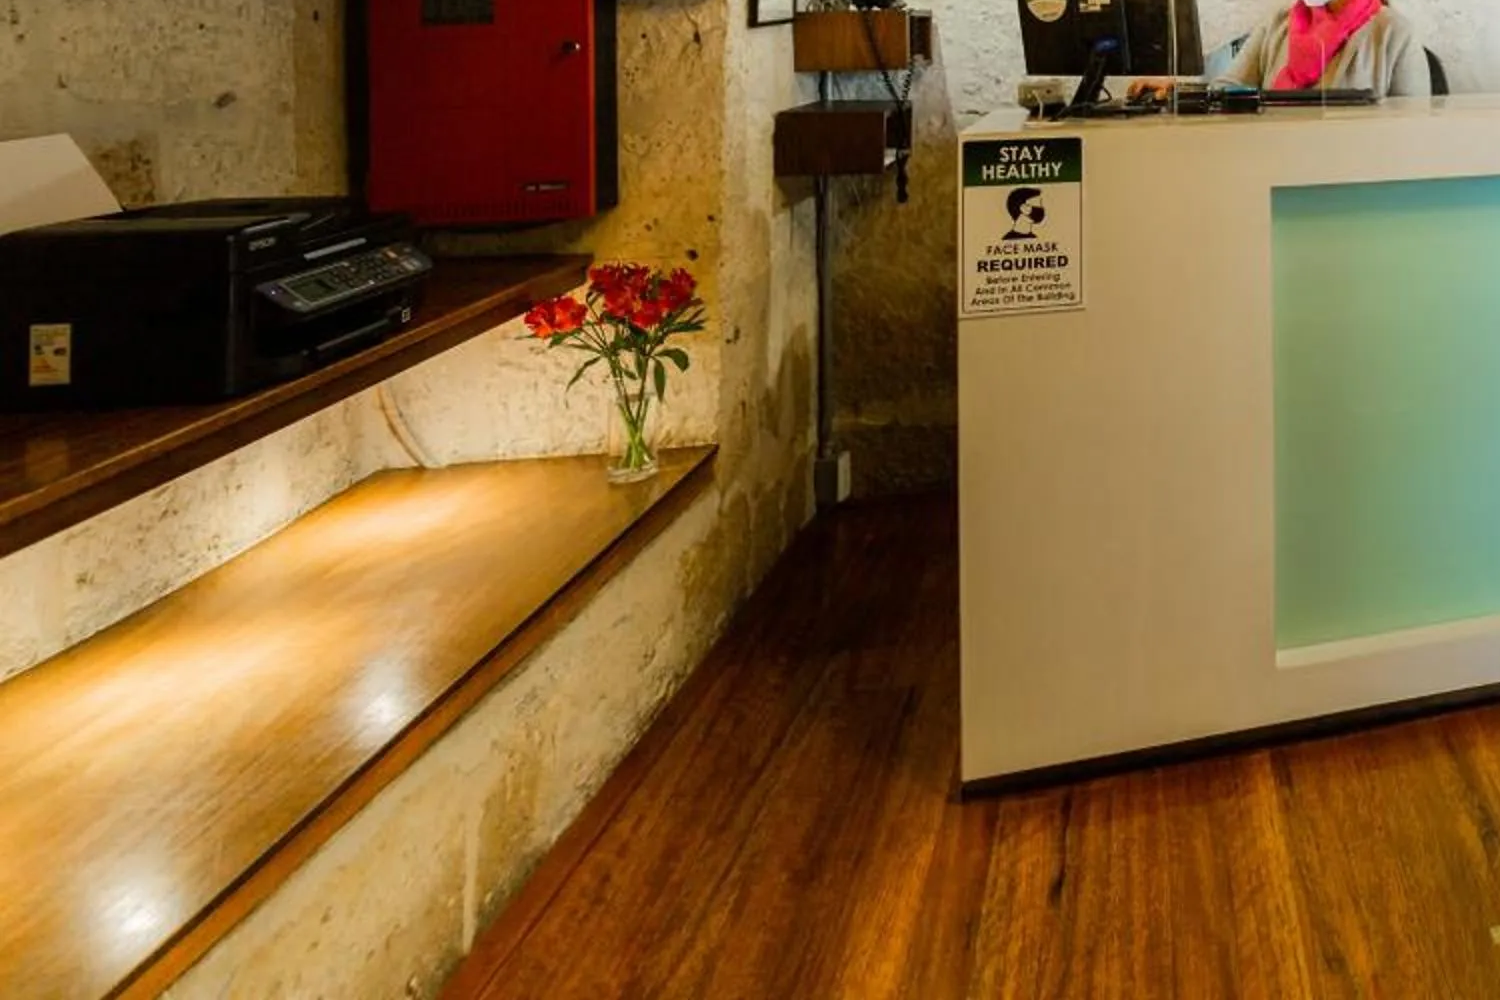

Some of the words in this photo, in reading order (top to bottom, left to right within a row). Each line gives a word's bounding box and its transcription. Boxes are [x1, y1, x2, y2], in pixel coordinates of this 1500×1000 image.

[1000, 145, 1045, 163] STAY
[982, 161, 1063, 181] HEALTHY
[986, 243, 1019, 256] FACE
[1023, 241, 1058, 253] MASK
[977, 255, 1069, 273] REQUIRED
